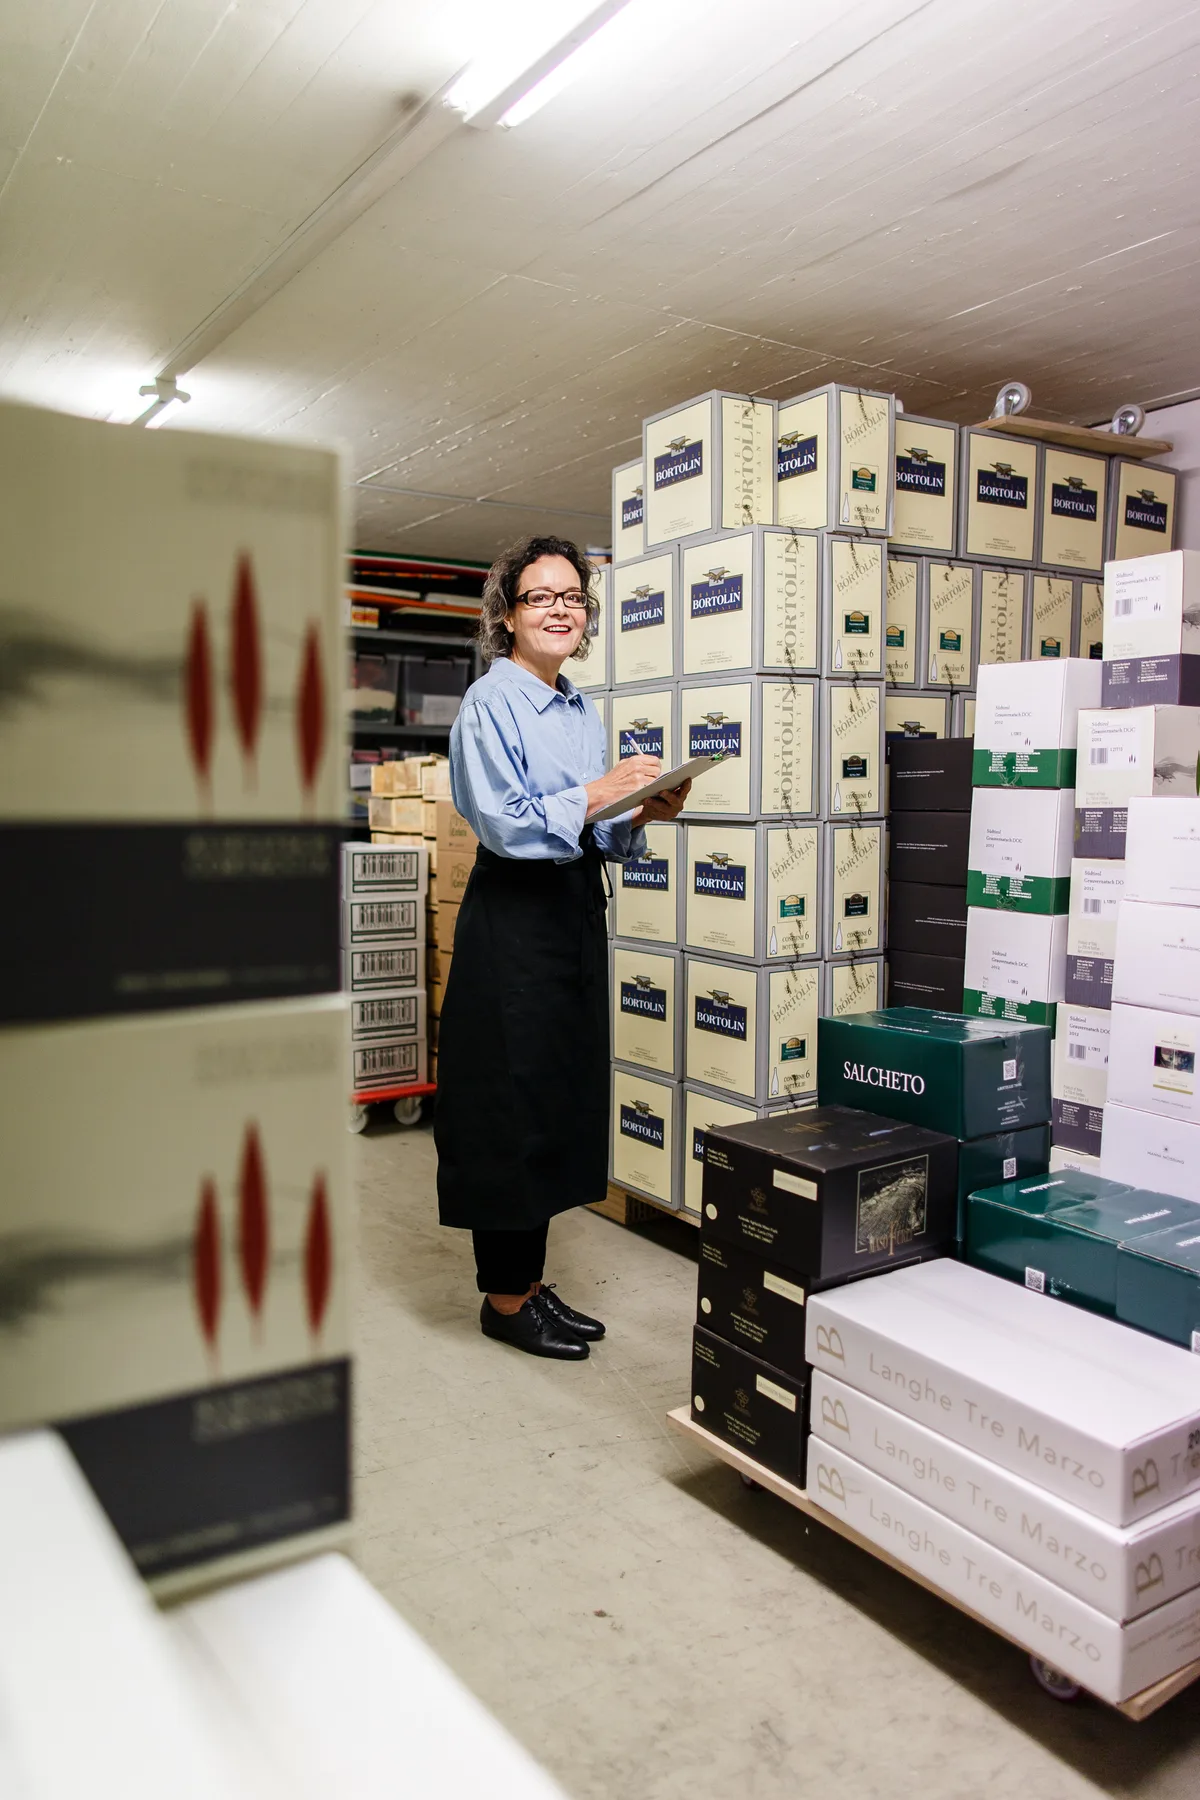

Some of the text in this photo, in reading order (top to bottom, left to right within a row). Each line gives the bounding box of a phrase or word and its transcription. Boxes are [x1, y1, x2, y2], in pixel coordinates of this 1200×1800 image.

[844, 409, 887, 444] BORTOLIN
[656, 456, 702, 483] BORTOLIN
[896, 471, 944, 488] BORTOLIN
[979, 484, 1026, 501] BORTOLIN
[875, 504, 880, 514] 6
[1053, 497, 1096, 514] BORTOLIN
[1126, 509, 1165, 526] BORTOLIN
[836, 556, 880, 593] BORTOLIN
[692, 591, 741, 611] BORTOLIN
[933, 577, 971, 611] BORTOLIN
[1035, 590, 1071, 621] BORTOLIN
[622, 606, 663, 625] BORTOLIN
[869, 649, 874, 658] 6
[904, 660, 909, 670] 6
[961, 664, 965, 673] 6
[834, 698, 878, 737] BORTOLIN
[691, 738, 740, 750] BORTOLIN
[867, 789, 872, 798] 6
[771, 839, 815, 880] BORTOLIN
[837, 839, 878, 878] BORTOLIN
[624, 871, 667, 883] BORTOLIN
[696, 877, 744, 892] BORTOLIN
[804, 932, 810, 940] 6
[867, 926, 872, 936] 6
[622, 996, 665, 1014] BORTOLIN
[773, 978, 817, 1022] BORTOLIN
[836, 972, 876, 1015] BORTOLIN
[696, 1011, 745, 1032] BORTOLIN
[805, 1069, 811, 1079] 6
[843, 1061, 925, 1096] SALCHETO
[621, 1118, 662, 1142] BORTOLIN
[816, 1324, 846, 1368] B
[821, 1395, 851, 1442] B
[869, 1352, 1105, 1490] Langhe Tre Marzo
[816, 1463, 848, 1511] B
[1132, 1457, 1161, 1508] B
[874, 1427, 1108, 1582] Langhe Tre Marzo
[869, 1497, 951, 1566] Langhe
[962, 1556, 1003, 1600] Tre
[1015, 1591, 1102, 1663] Marzo
[1135, 1551, 1165, 1602] B
